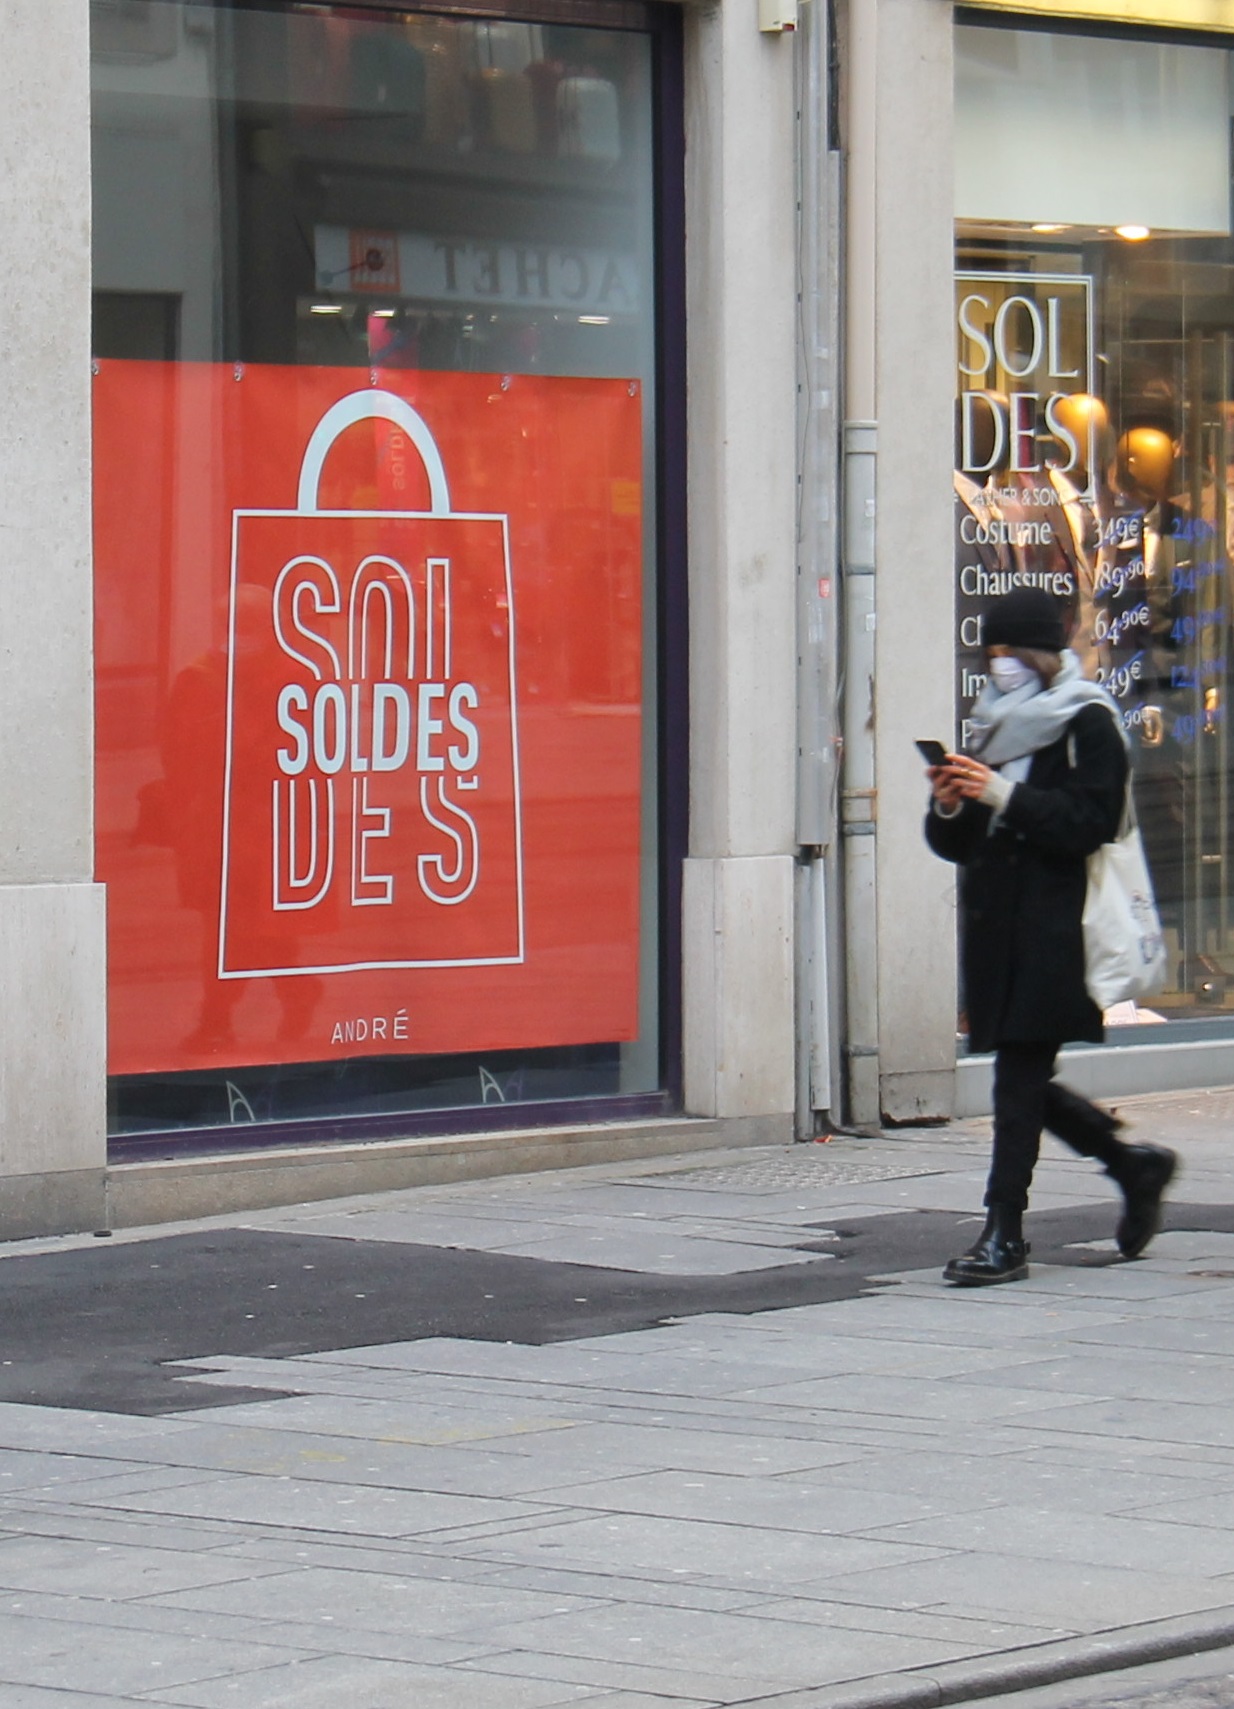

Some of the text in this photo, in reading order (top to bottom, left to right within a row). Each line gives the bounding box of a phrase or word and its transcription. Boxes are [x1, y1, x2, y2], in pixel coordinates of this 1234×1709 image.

[957, 295, 1079, 380] SOL
[960, 388, 1078, 474] DES
[960, 514, 1051, 546] Costume
[276, 683, 479, 775] SOLDES
[330, 1007, 410, 1045] ANDRÉ
